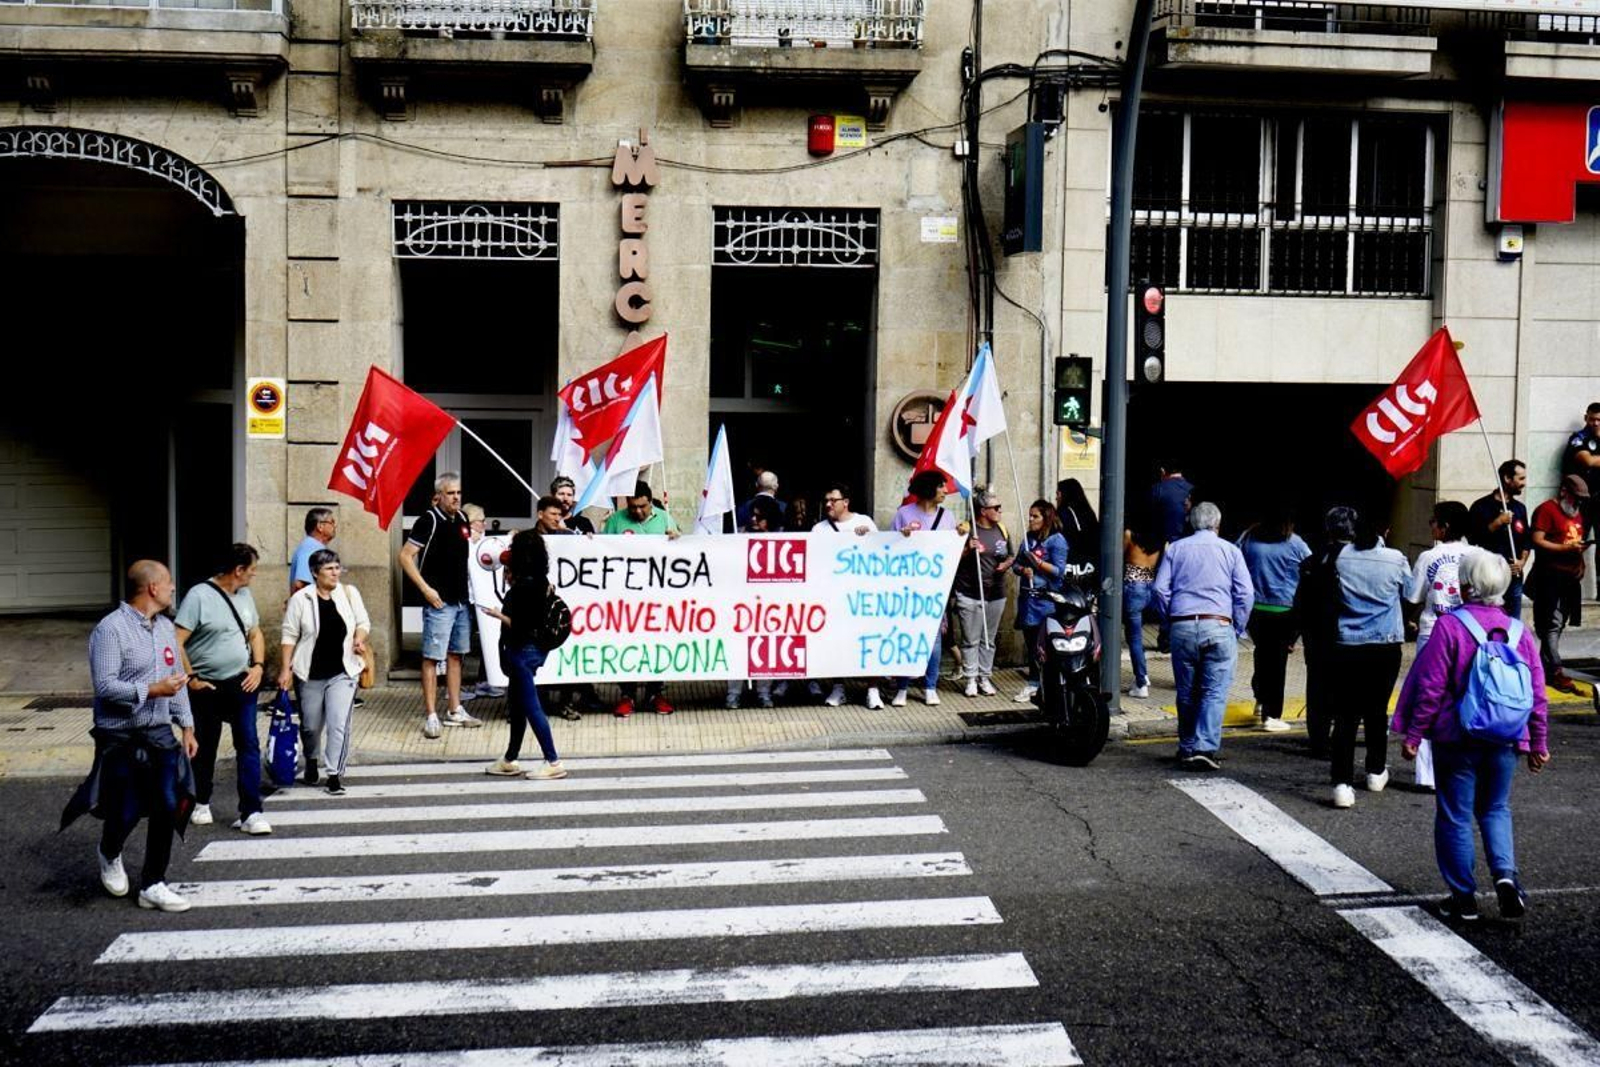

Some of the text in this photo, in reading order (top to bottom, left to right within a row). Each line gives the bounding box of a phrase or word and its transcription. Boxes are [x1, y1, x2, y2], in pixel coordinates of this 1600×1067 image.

[572, 372, 634, 413] CIG
[1366, 379, 1437, 444] CIG
[342, 420, 390, 490] CIG
[557, 551, 713, 591] DEFENSA
[749, 540, 804, 575] CIG
[834, 545, 944, 579] SINDICATOS
[1064, 562, 1095, 576] FILA
[571, 596, 827, 637] CONVENIO DIGNO
[847, 586, 944, 620] VENDIDOS
[557, 638, 729, 677] MERCADONA
[750, 634, 805, 669] CIG
[858, 625, 931, 669] FÓRA
